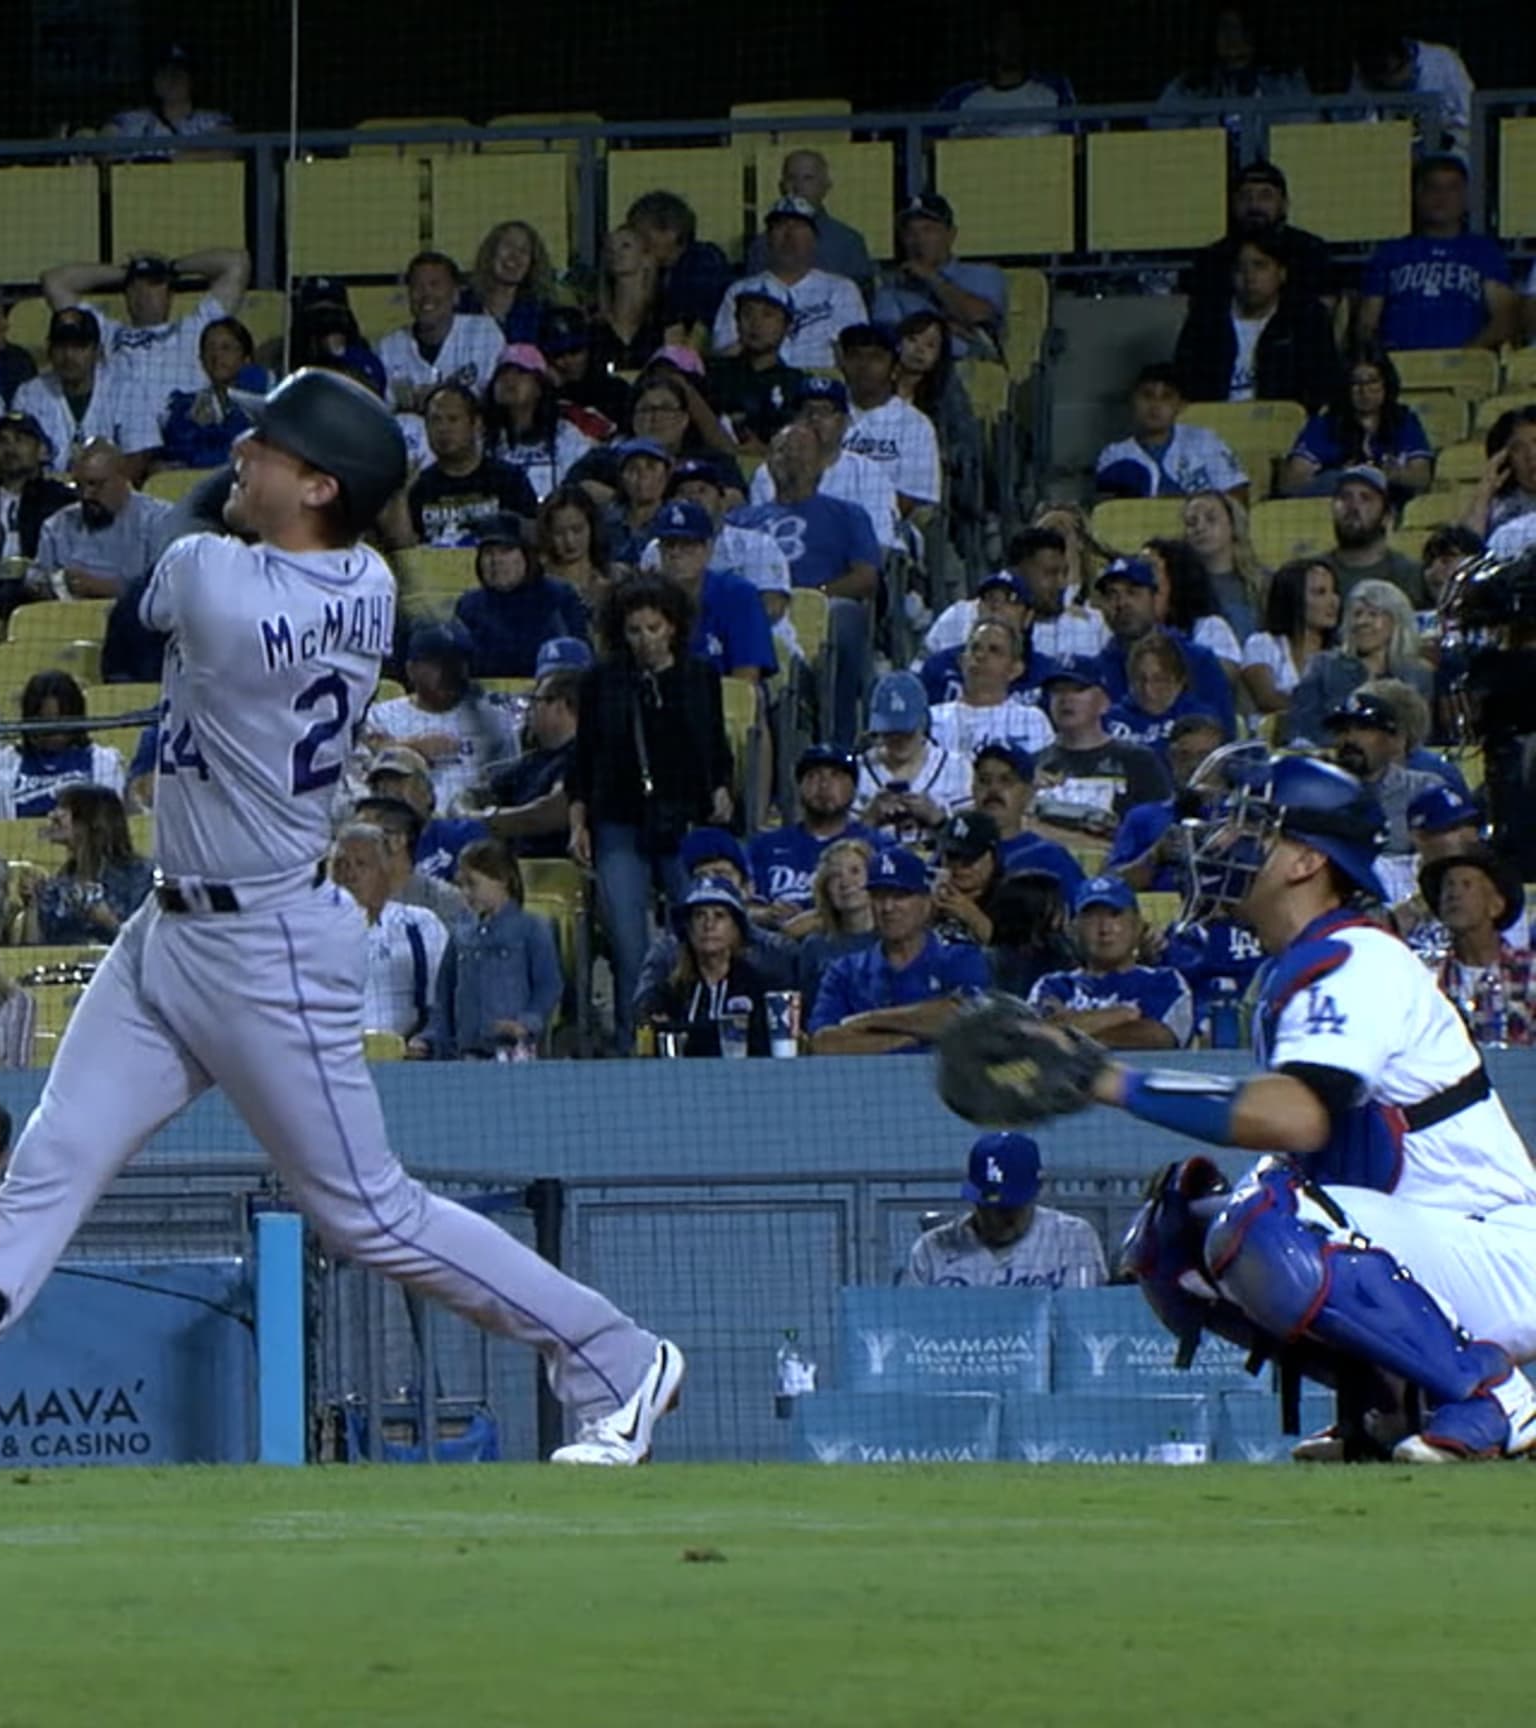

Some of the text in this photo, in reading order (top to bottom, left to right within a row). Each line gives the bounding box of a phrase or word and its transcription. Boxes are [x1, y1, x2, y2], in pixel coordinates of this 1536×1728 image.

[880, 854, 896, 875] LA
[1230, 926, 1262, 960] LA
[1305, 986, 1346, 1035] LA
[986, 1156, 1004, 1184] LA
[1, 1436, 20, 1458] &
[31, 1431, 150, 1458] CASINO
[1068, 1445, 1150, 1464] YAAM
